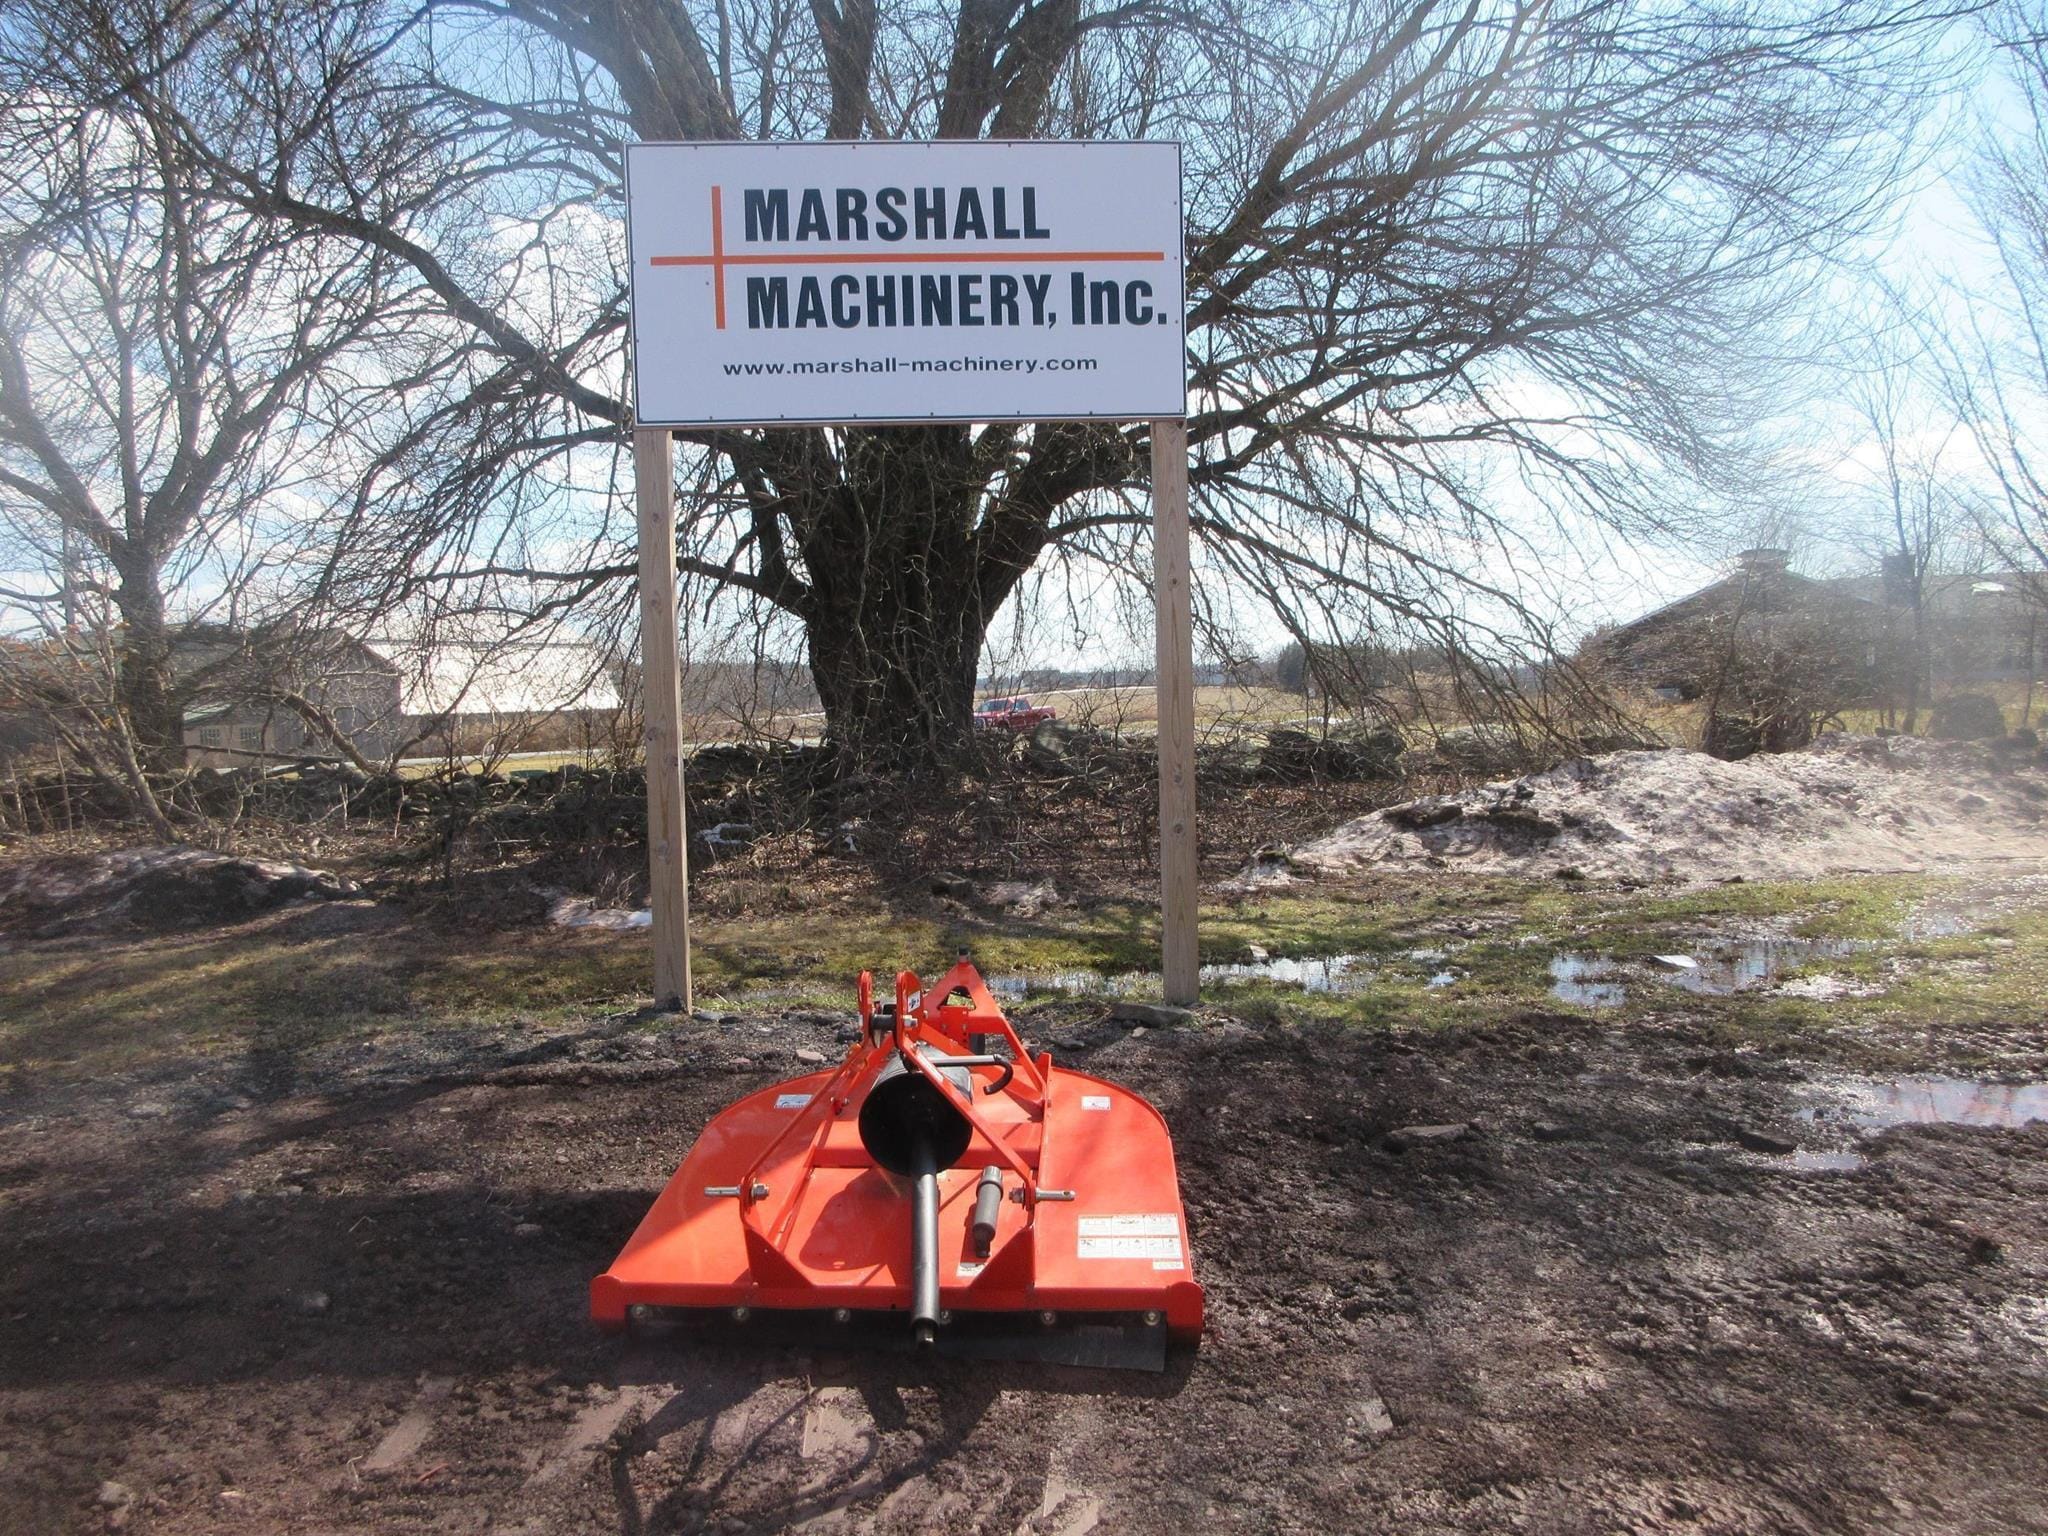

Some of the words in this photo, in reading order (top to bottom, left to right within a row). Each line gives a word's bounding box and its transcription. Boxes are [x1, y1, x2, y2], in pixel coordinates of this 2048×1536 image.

[744, 186, 1050, 242] MARSHALL
[746, 273, 1057, 330] MACHINERY,
[1070, 271, 1168, 326] Inc.
[723, 356, 1098, 376] www.marshall-machinery.com
